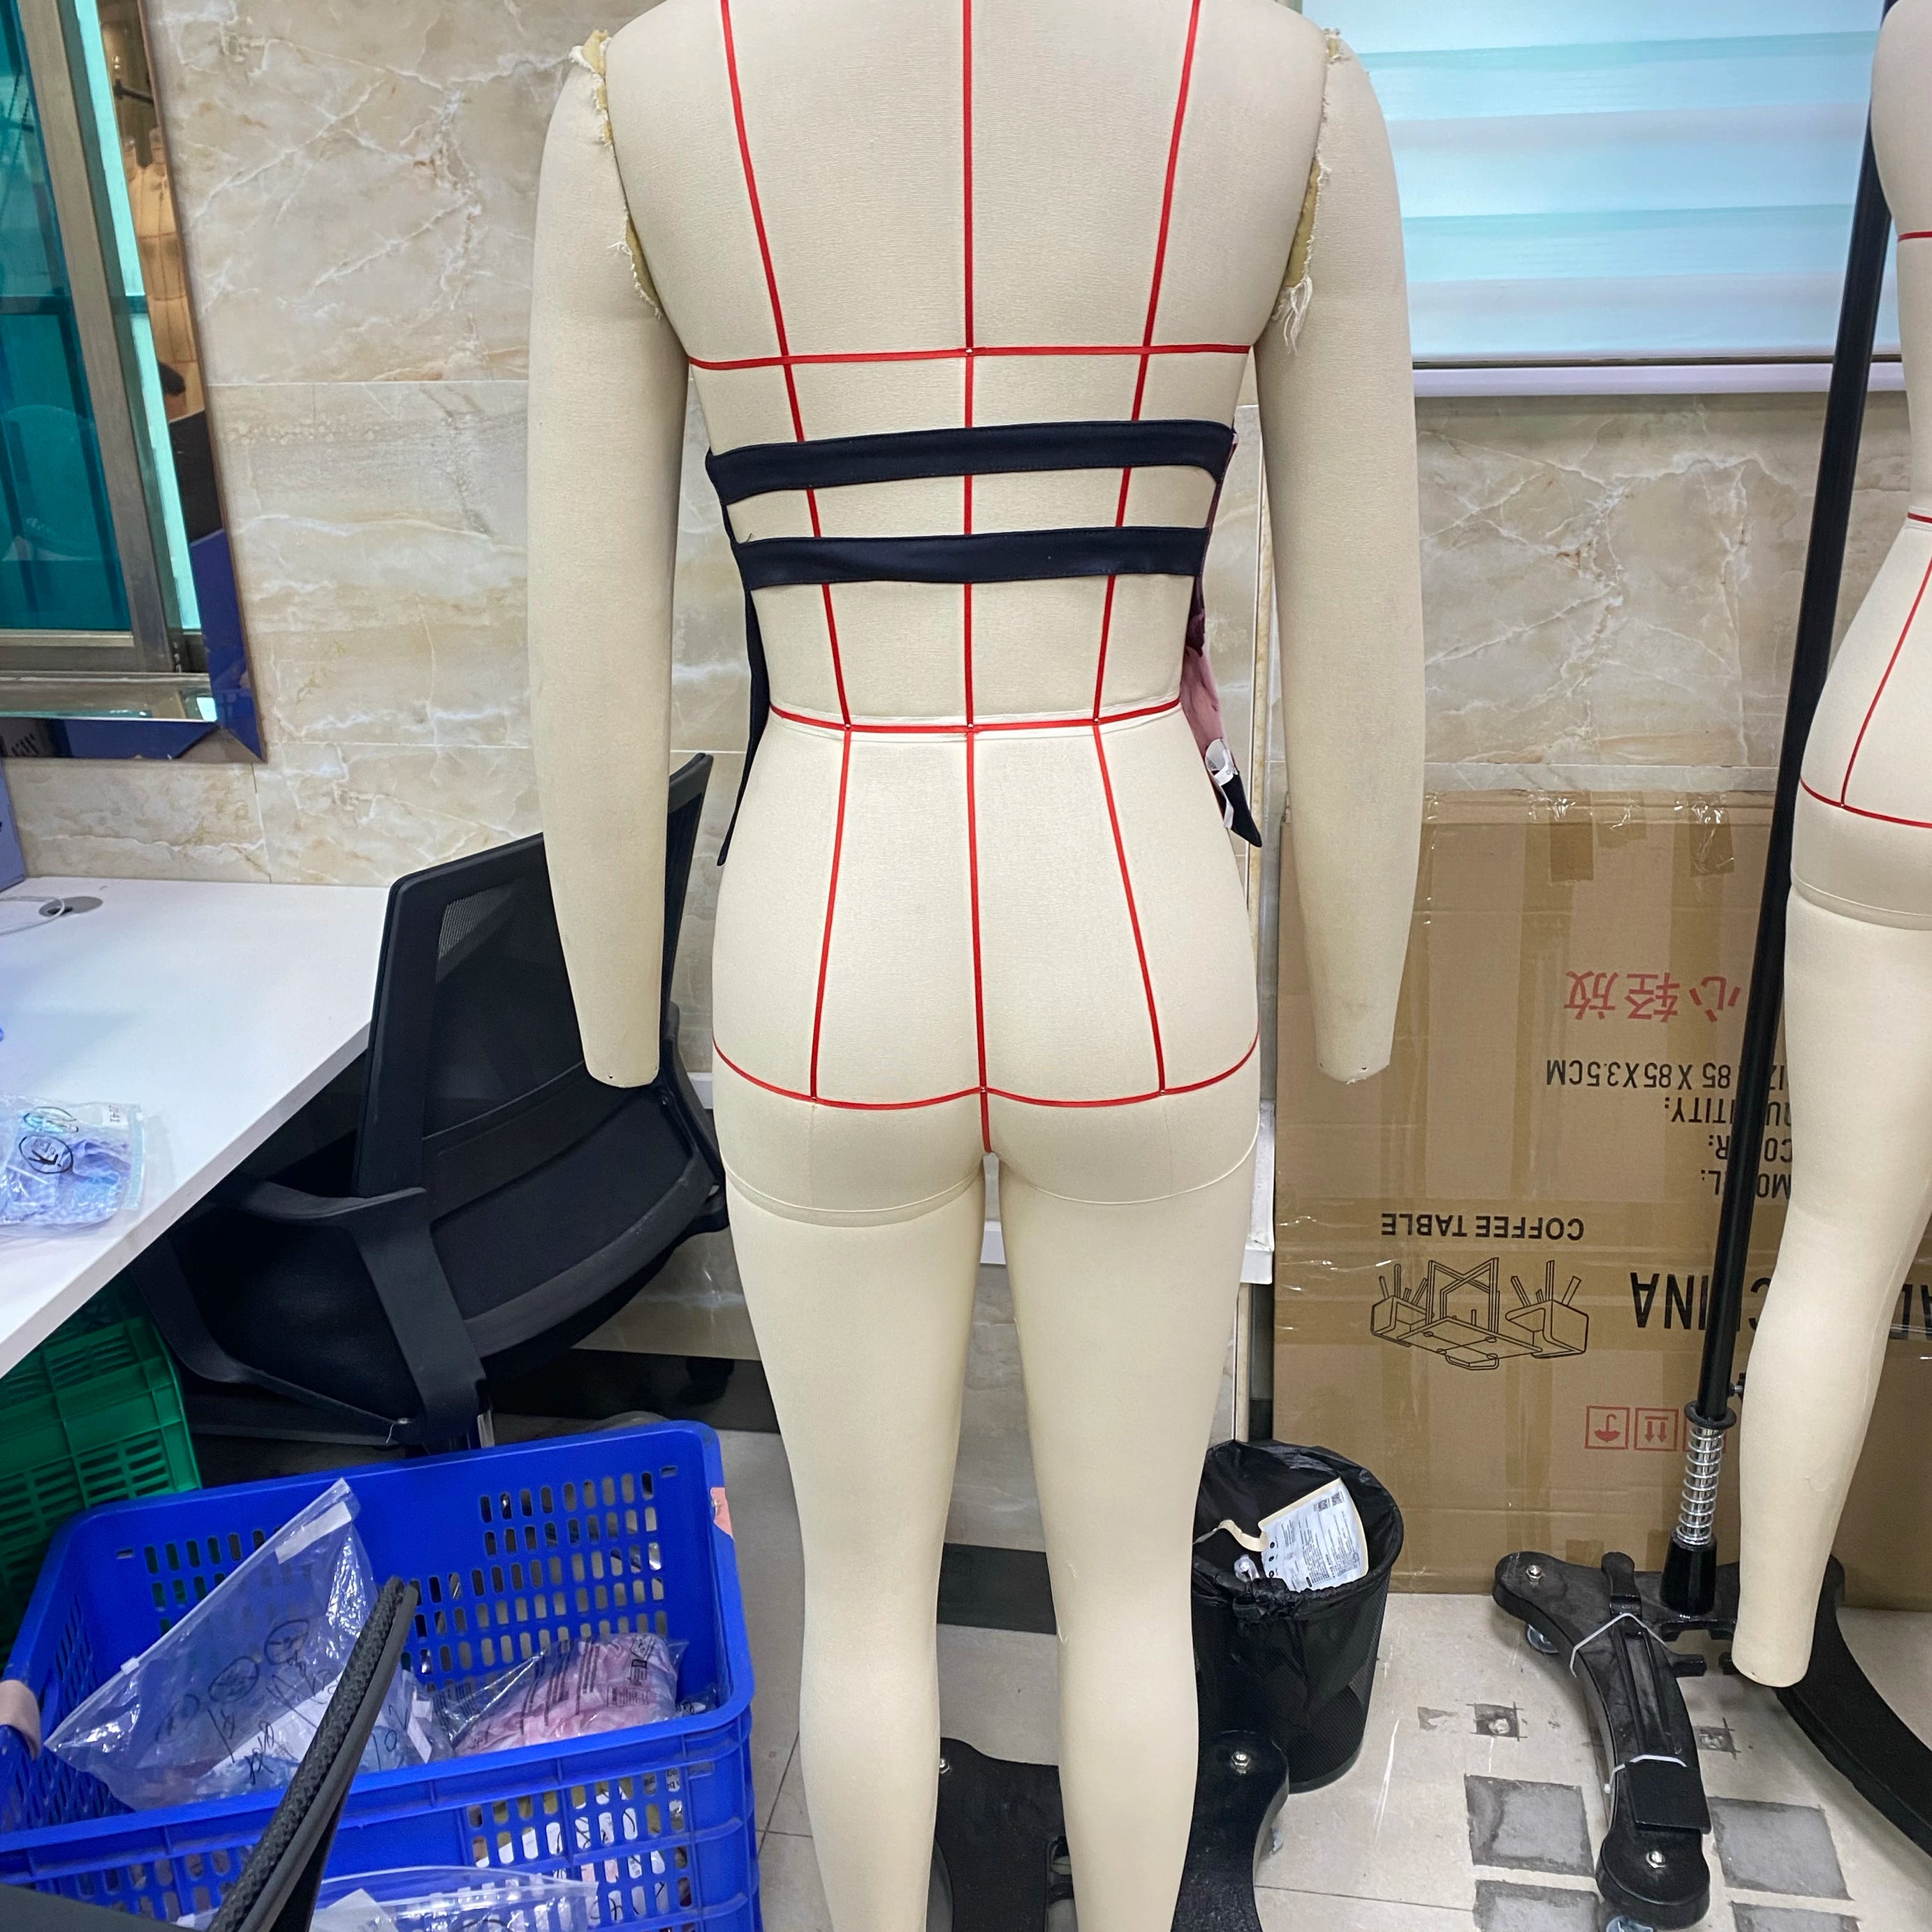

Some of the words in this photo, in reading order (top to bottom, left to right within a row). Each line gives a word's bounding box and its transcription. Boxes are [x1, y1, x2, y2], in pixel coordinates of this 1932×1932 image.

[1564, 971, 1741, 1023] 心轻放
[1702, 1064, 1731, 1088] 85
[1708, 1135, 1792, 1163] COR:
[1701, 1169, 1791, 1199] MOL:
[1382, 1213, 1468, 1236] TABLE
[1476, 1216, 1585, 1241] COFFEE
[1630, 1273, 1771, 1332] CINA
